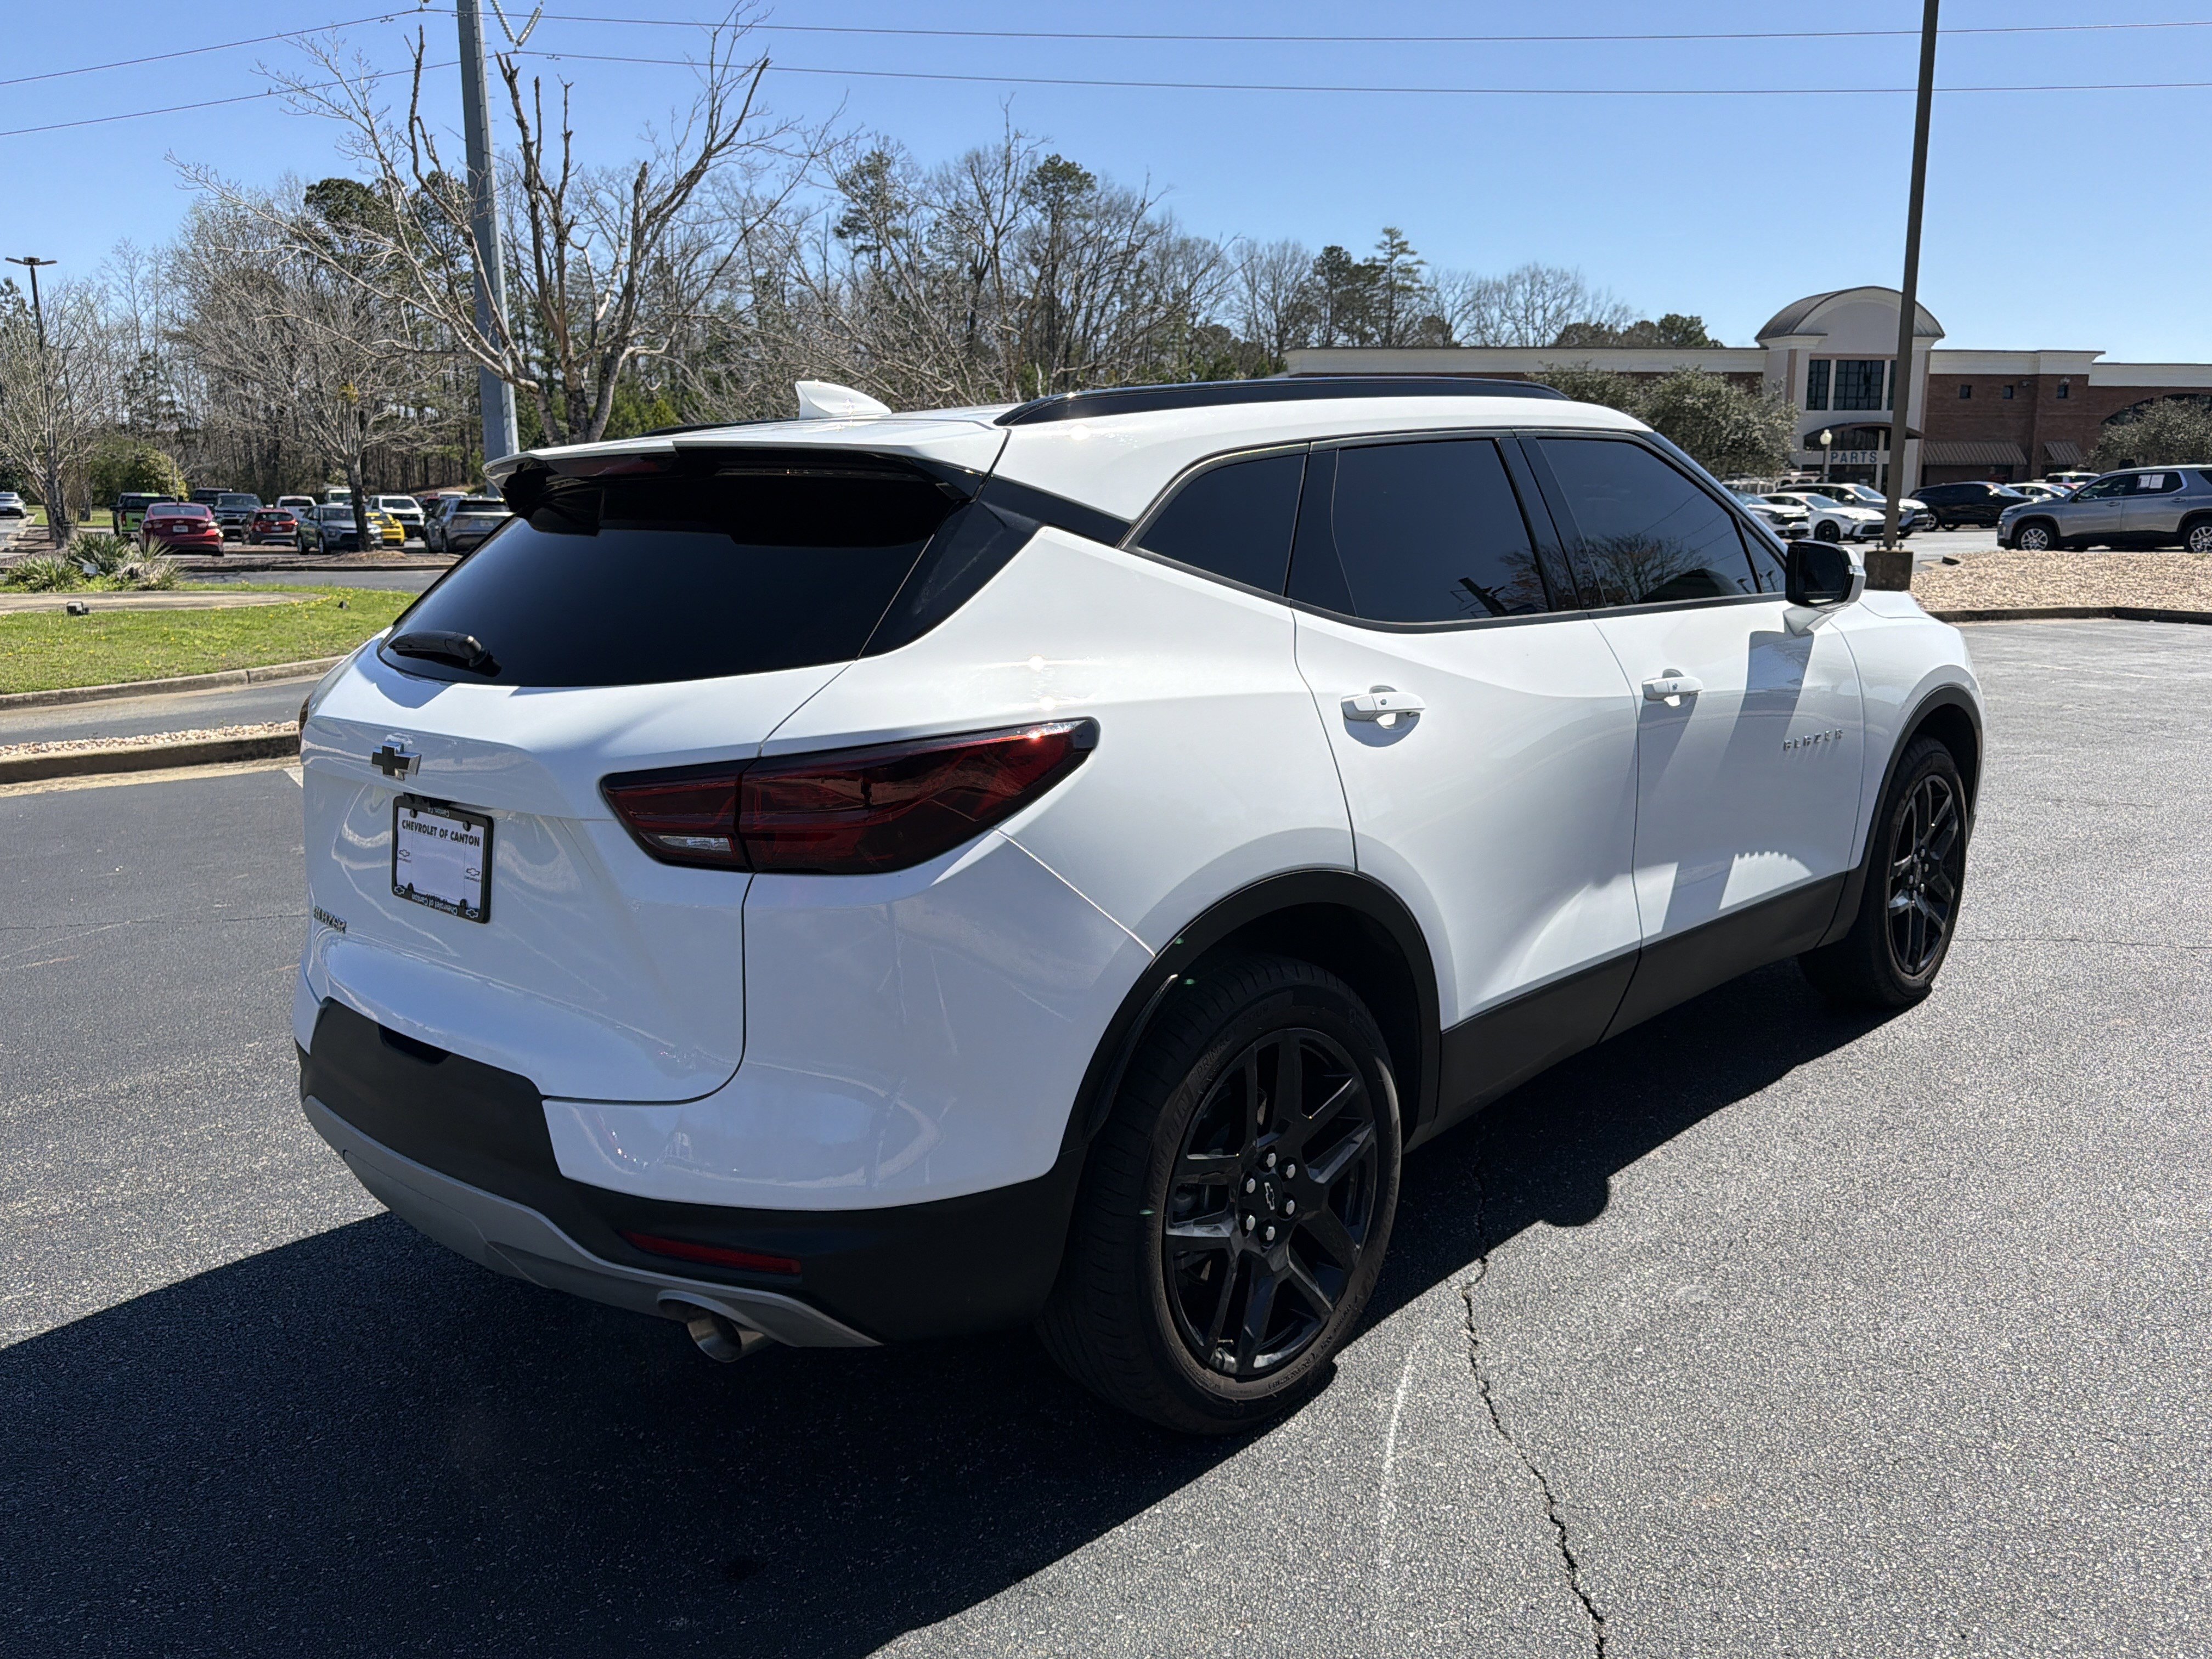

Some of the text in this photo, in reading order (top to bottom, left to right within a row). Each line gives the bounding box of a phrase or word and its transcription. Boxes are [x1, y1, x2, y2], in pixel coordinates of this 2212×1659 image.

[1830, 452, 1877, 464] PARTS
[1783, 729, 1843, 751] BLAZER
[402, 820, 480, 847] CHEVROLET OF CANTON
